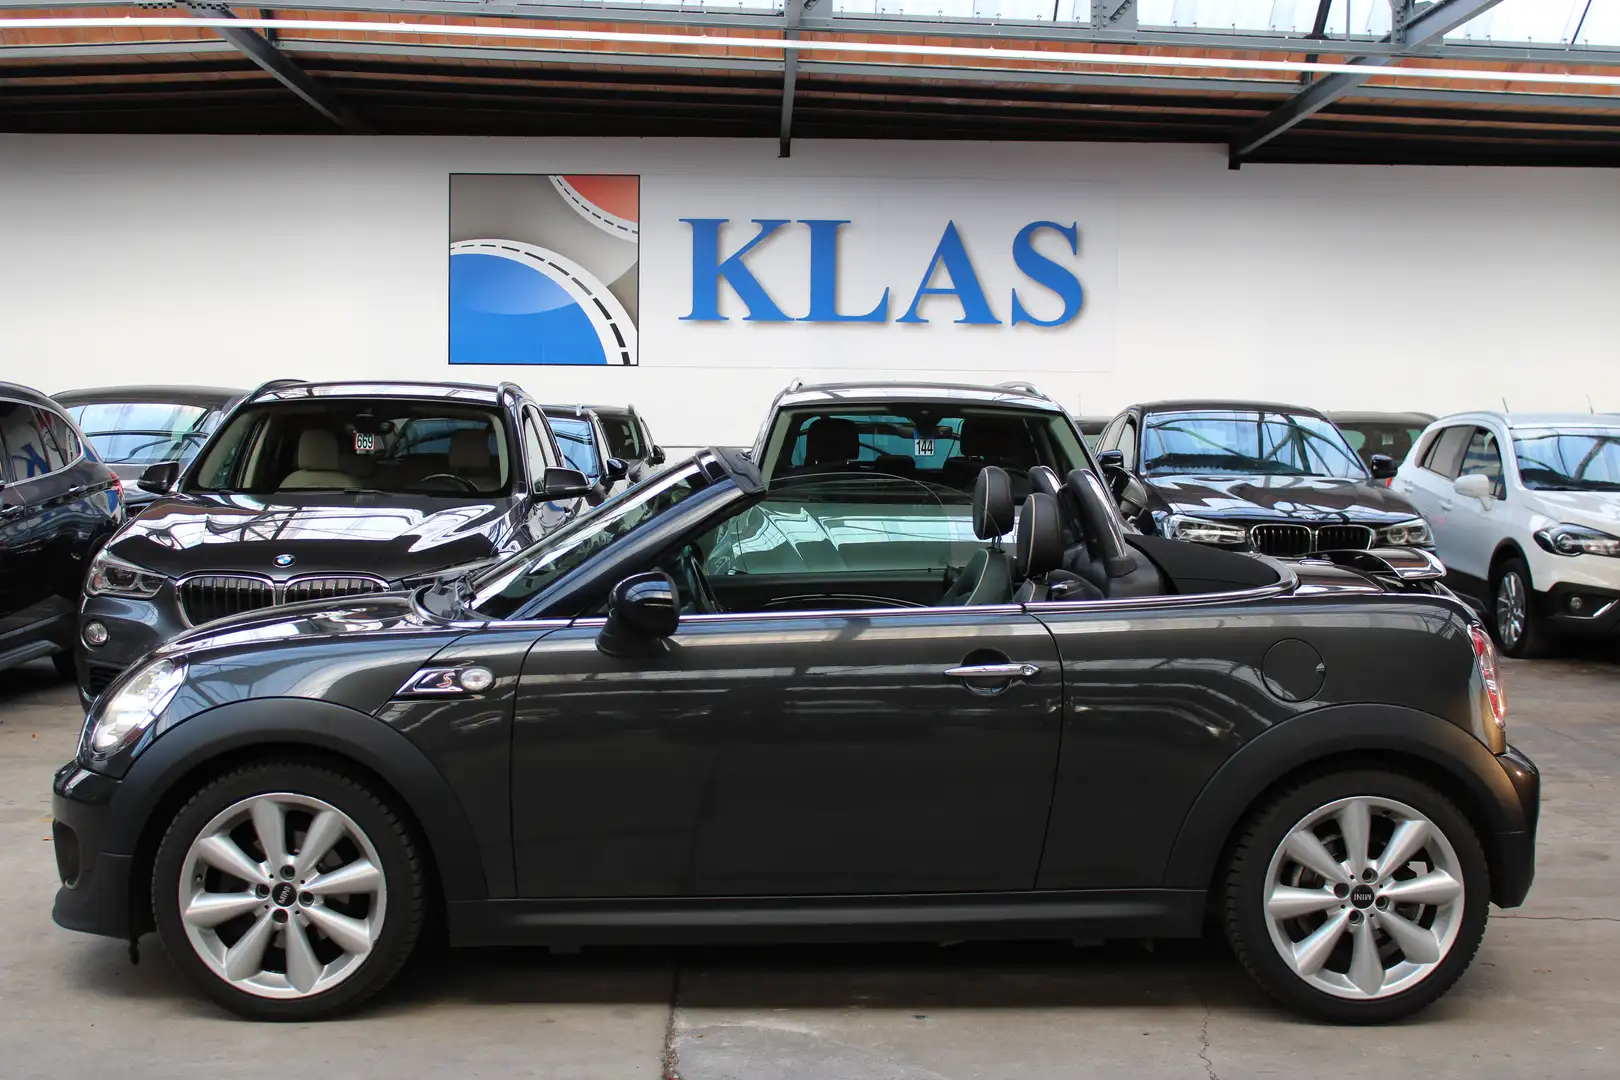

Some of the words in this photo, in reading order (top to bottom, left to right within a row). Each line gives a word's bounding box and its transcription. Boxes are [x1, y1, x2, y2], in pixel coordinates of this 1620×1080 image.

[678, 218, 1085, 327] KLAS
[356, 433, 373, 449] 669
[916, 439, 934, 455] 144
[278, 885, 291, 904] MINI
